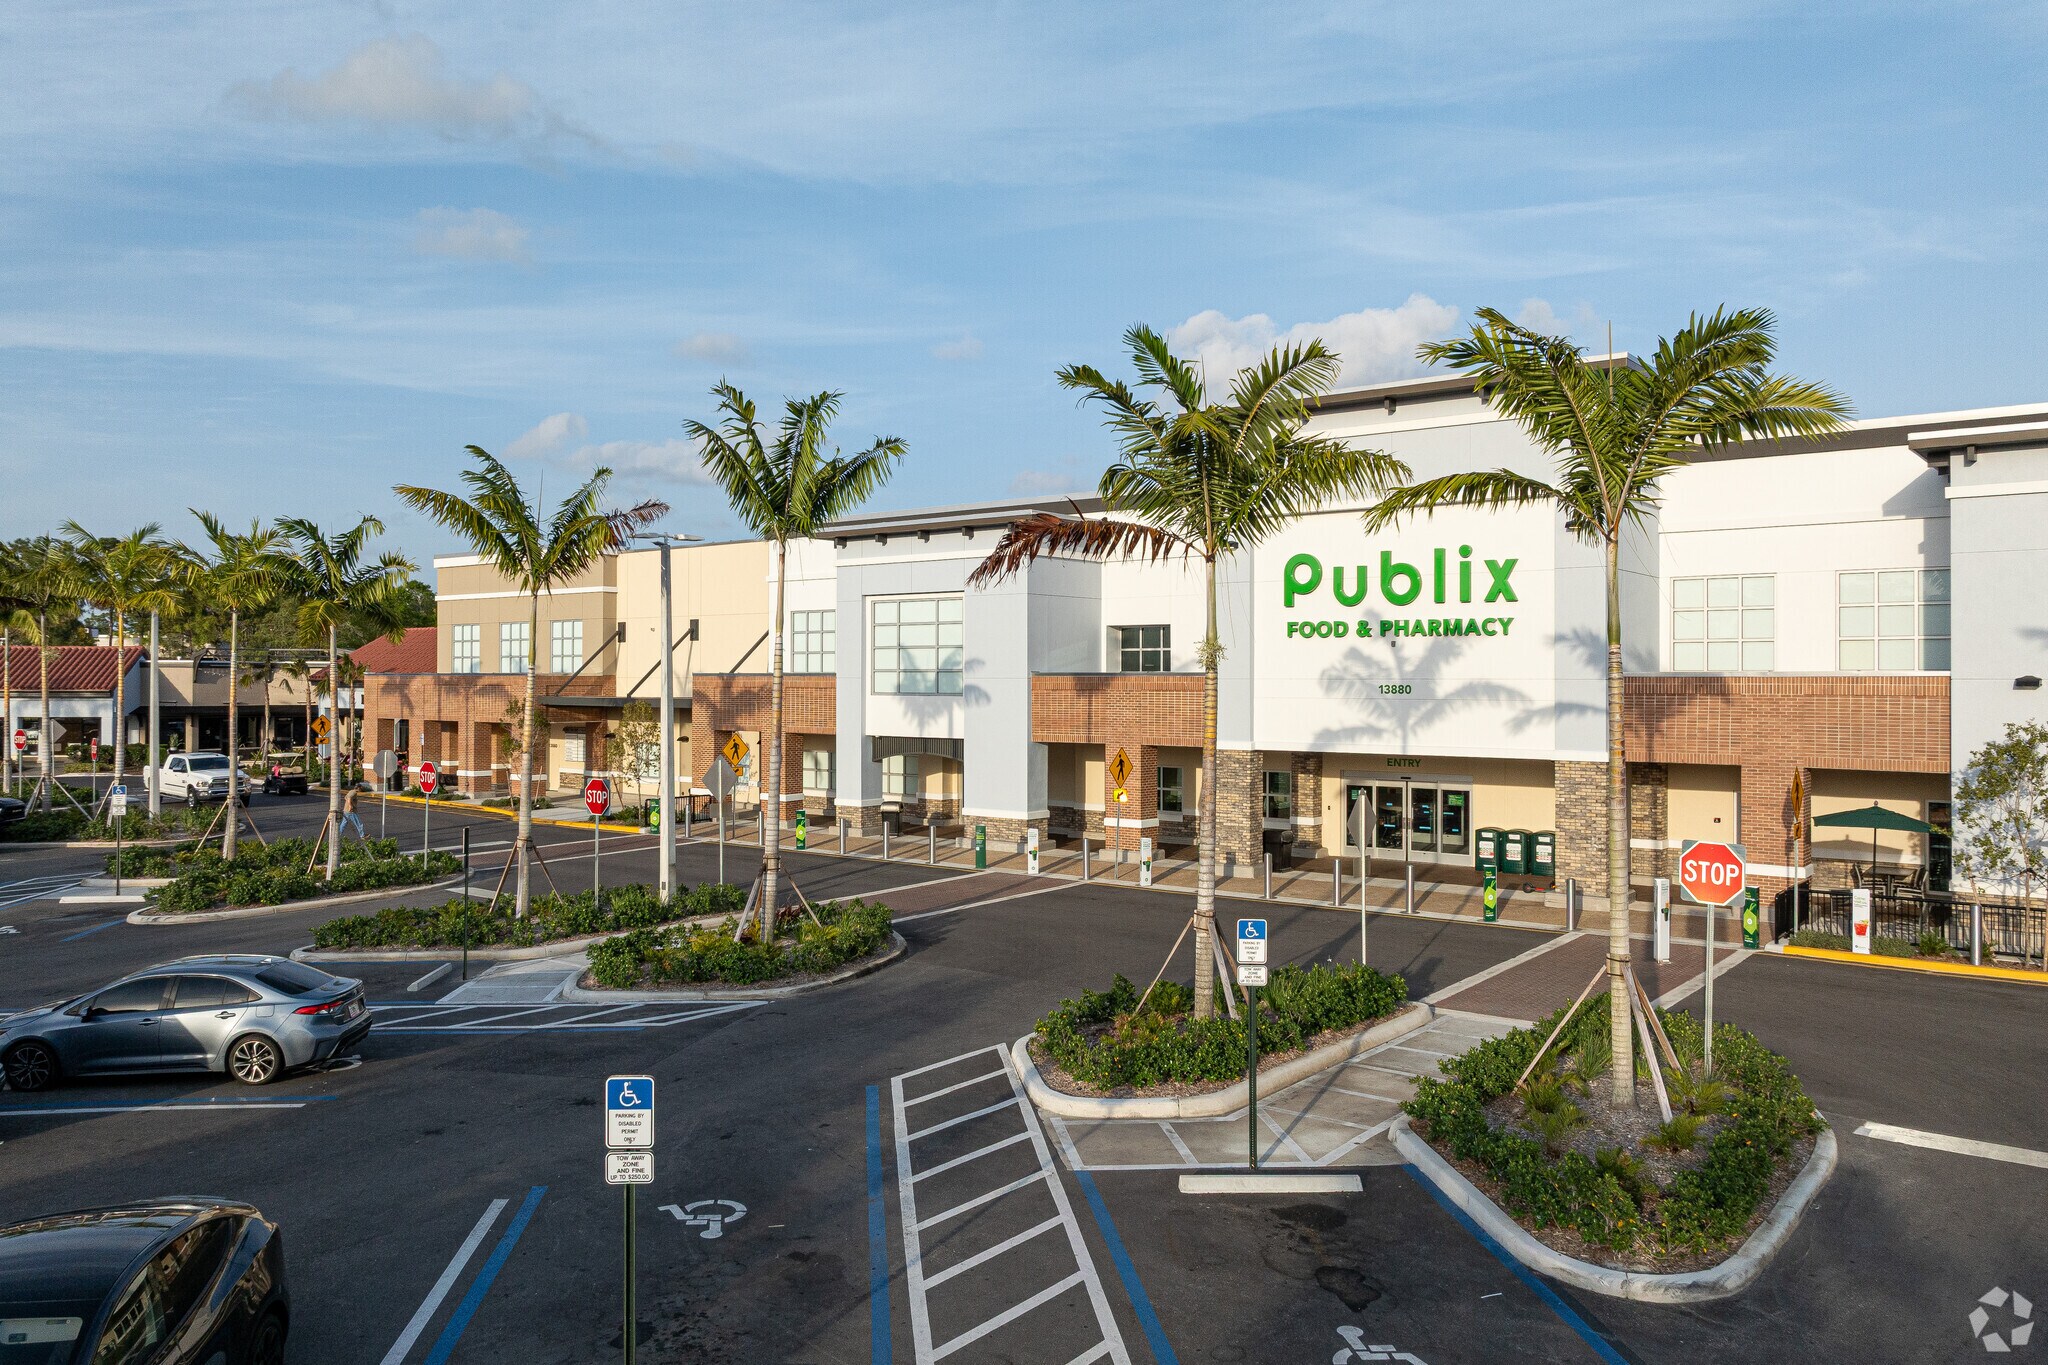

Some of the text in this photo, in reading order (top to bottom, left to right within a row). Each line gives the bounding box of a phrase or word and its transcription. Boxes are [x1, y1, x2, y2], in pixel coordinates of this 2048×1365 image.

[1284, 544, 1519, 607] Publix
[1287, 617, 1515, 638] FOOD & PHARMACY
[1378, 684, 1412, 695] 13880
[1387, 758, 1421, 768] ENTRY
[420, 771, 436, 784] STOP
[587, 789, 607, 804] STOP
[1684, 859, 1740, 887] STOP
